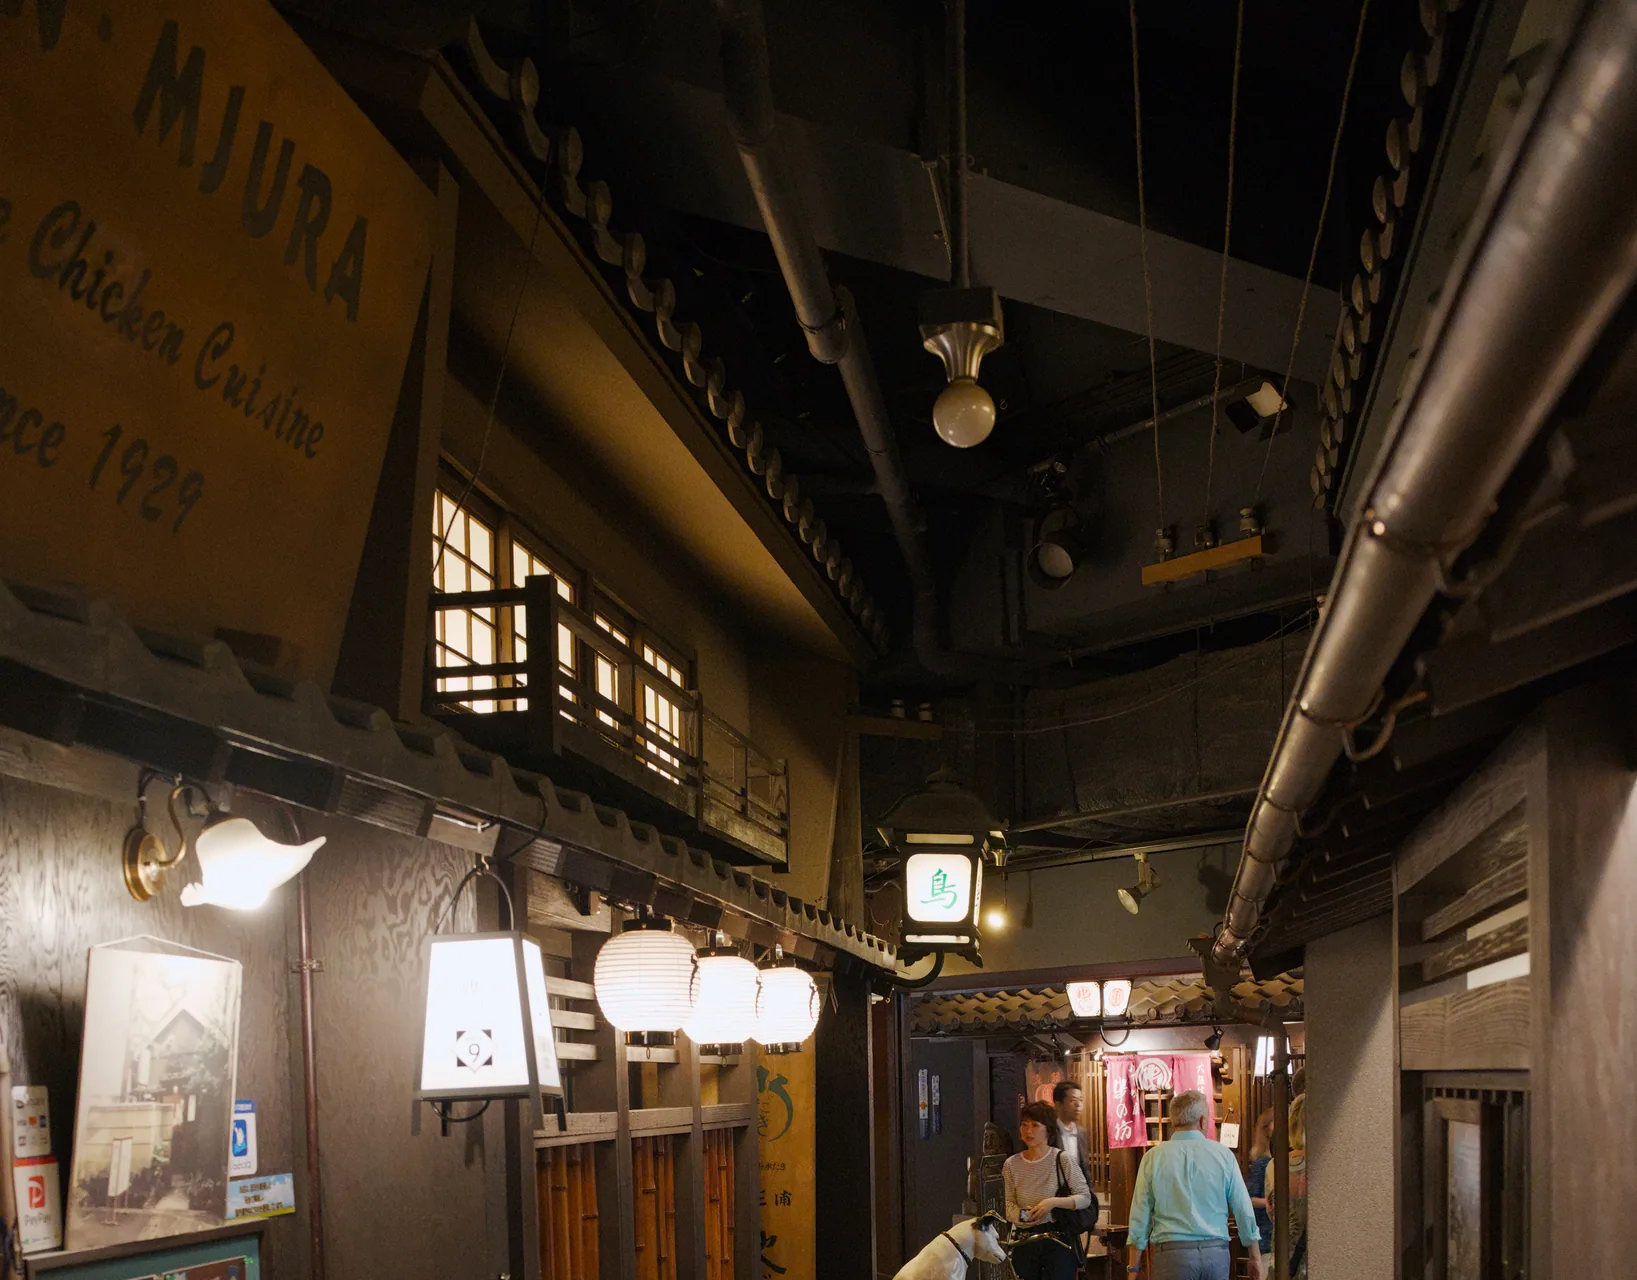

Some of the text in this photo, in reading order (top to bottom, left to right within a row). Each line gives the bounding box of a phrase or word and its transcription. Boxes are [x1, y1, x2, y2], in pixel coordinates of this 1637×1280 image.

[28, 199, 326, 460] Chicken Cuisine
[90, 423, 206, 533] 1929
[920, 868, 958, 910] 鳥
[758, 1162, 786, 1172] ・水たき
[24, 1212, 52, 1228] PayPay
